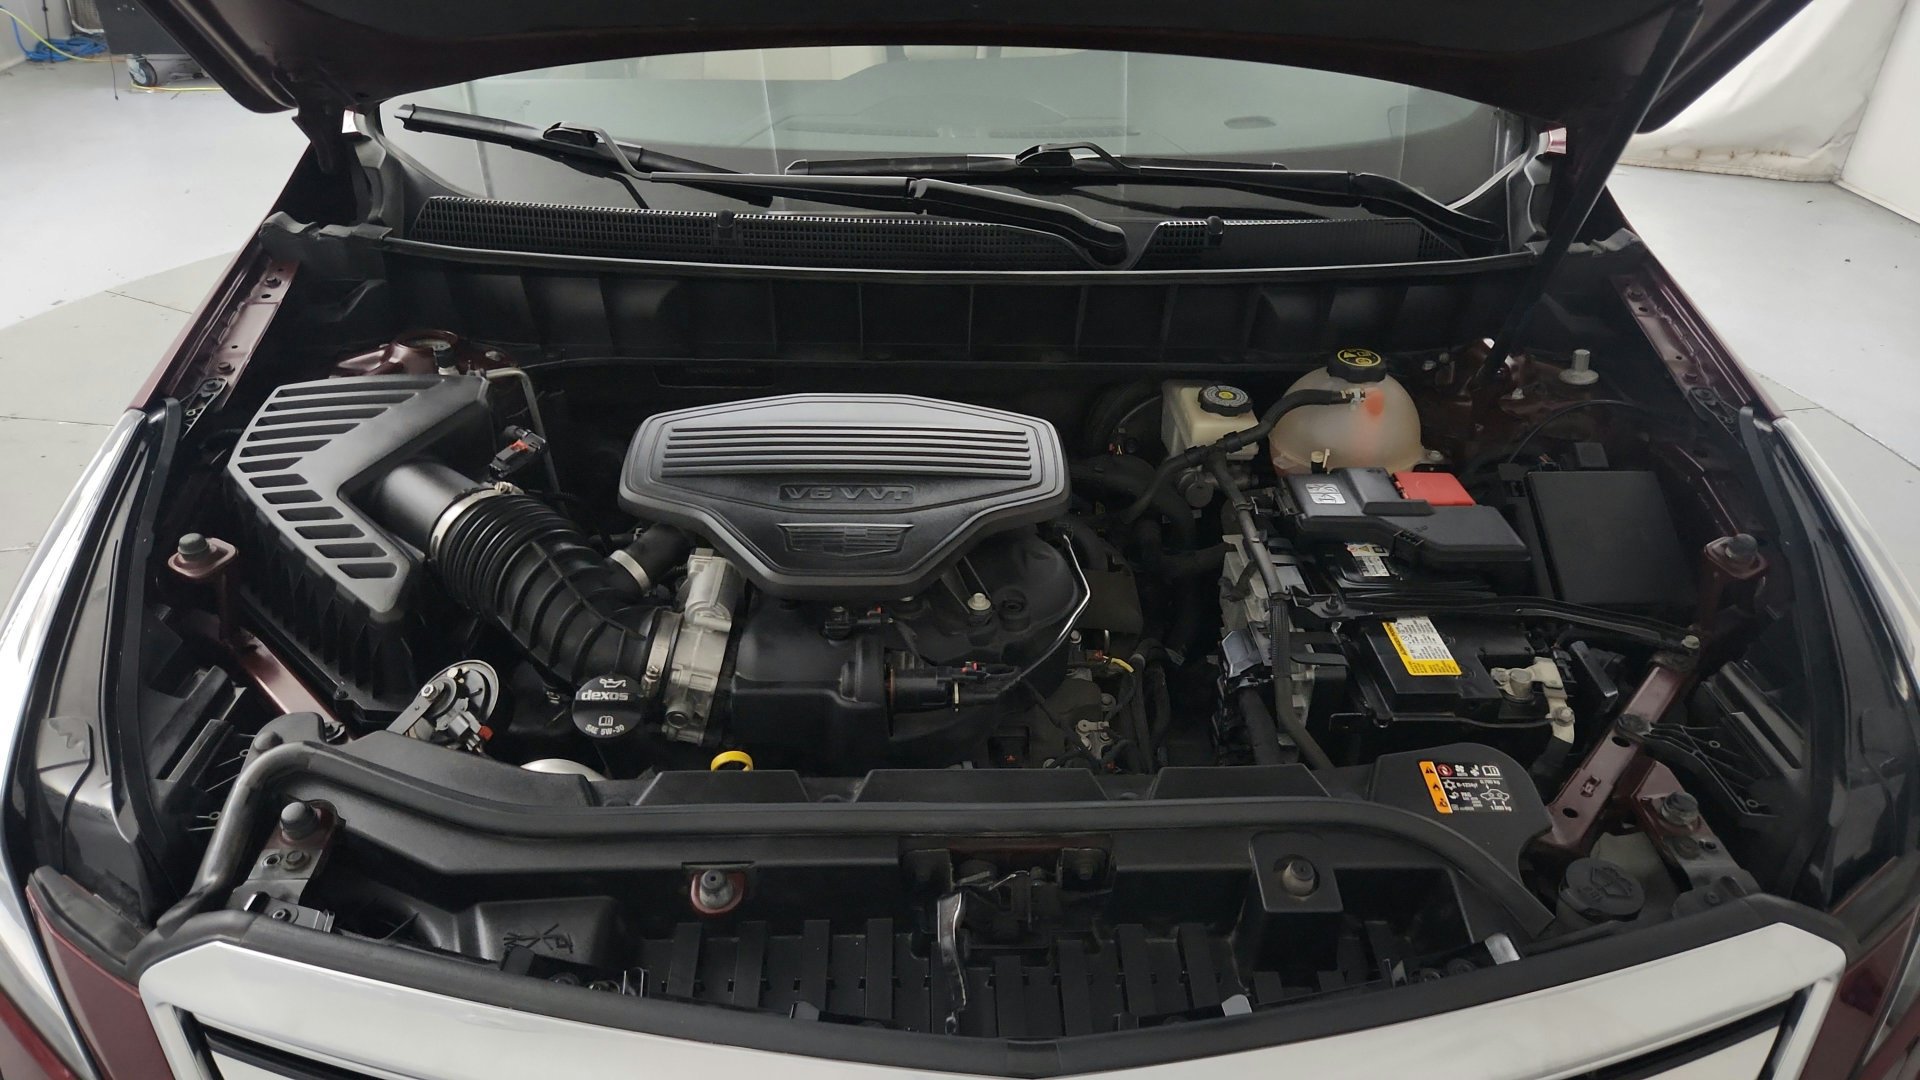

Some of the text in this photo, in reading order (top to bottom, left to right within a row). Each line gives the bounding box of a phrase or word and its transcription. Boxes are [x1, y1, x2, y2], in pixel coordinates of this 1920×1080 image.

[785, 487, 910, 500] V6 VVT
[582, 690, 629, 700] dexos
[585, 724, 625, 735] SAE 5W-30
